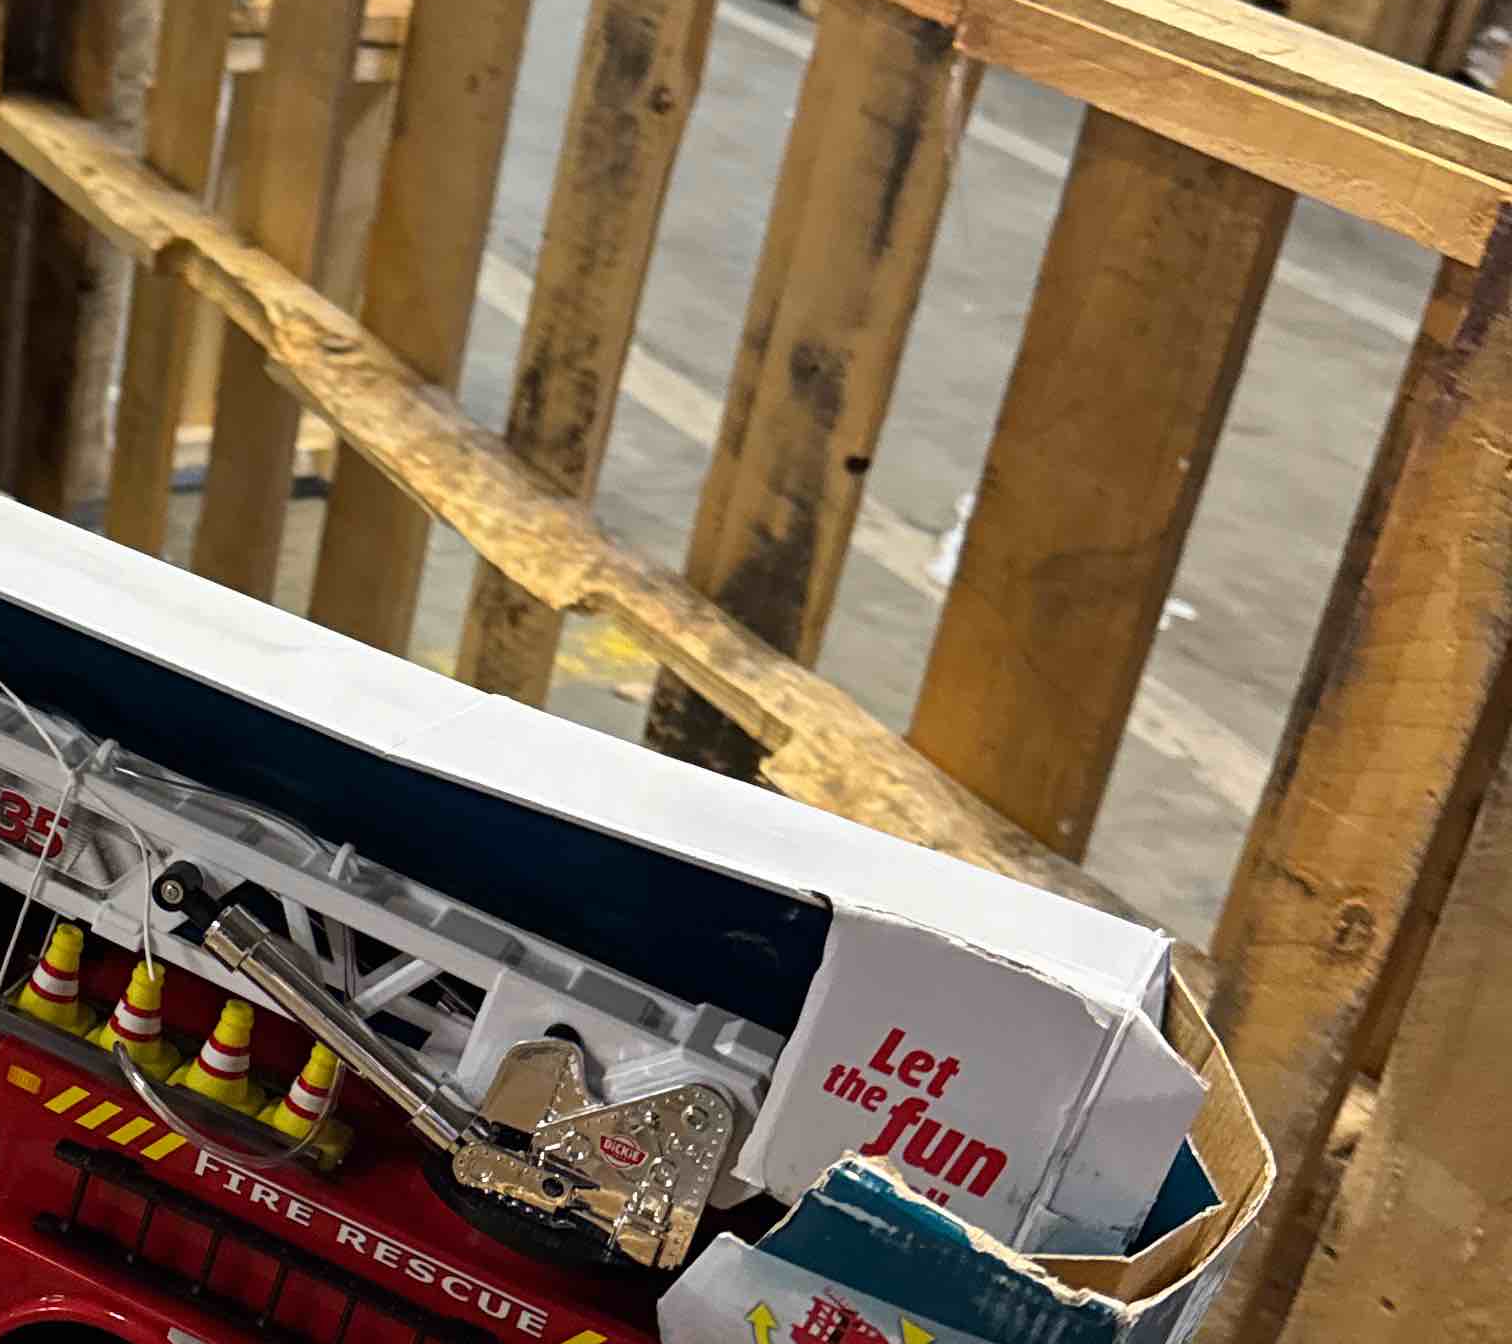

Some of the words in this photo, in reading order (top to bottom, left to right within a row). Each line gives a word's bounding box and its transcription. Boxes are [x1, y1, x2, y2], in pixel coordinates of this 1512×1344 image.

[823, 1063, 887, 1113] the
[858, 1096, 1008, 1198] fun
[868, 1027, 961, 1099] Let
[193, 1150, 315, 1227] FIRE
[335, 1222, 551, 1339] RESCUE
